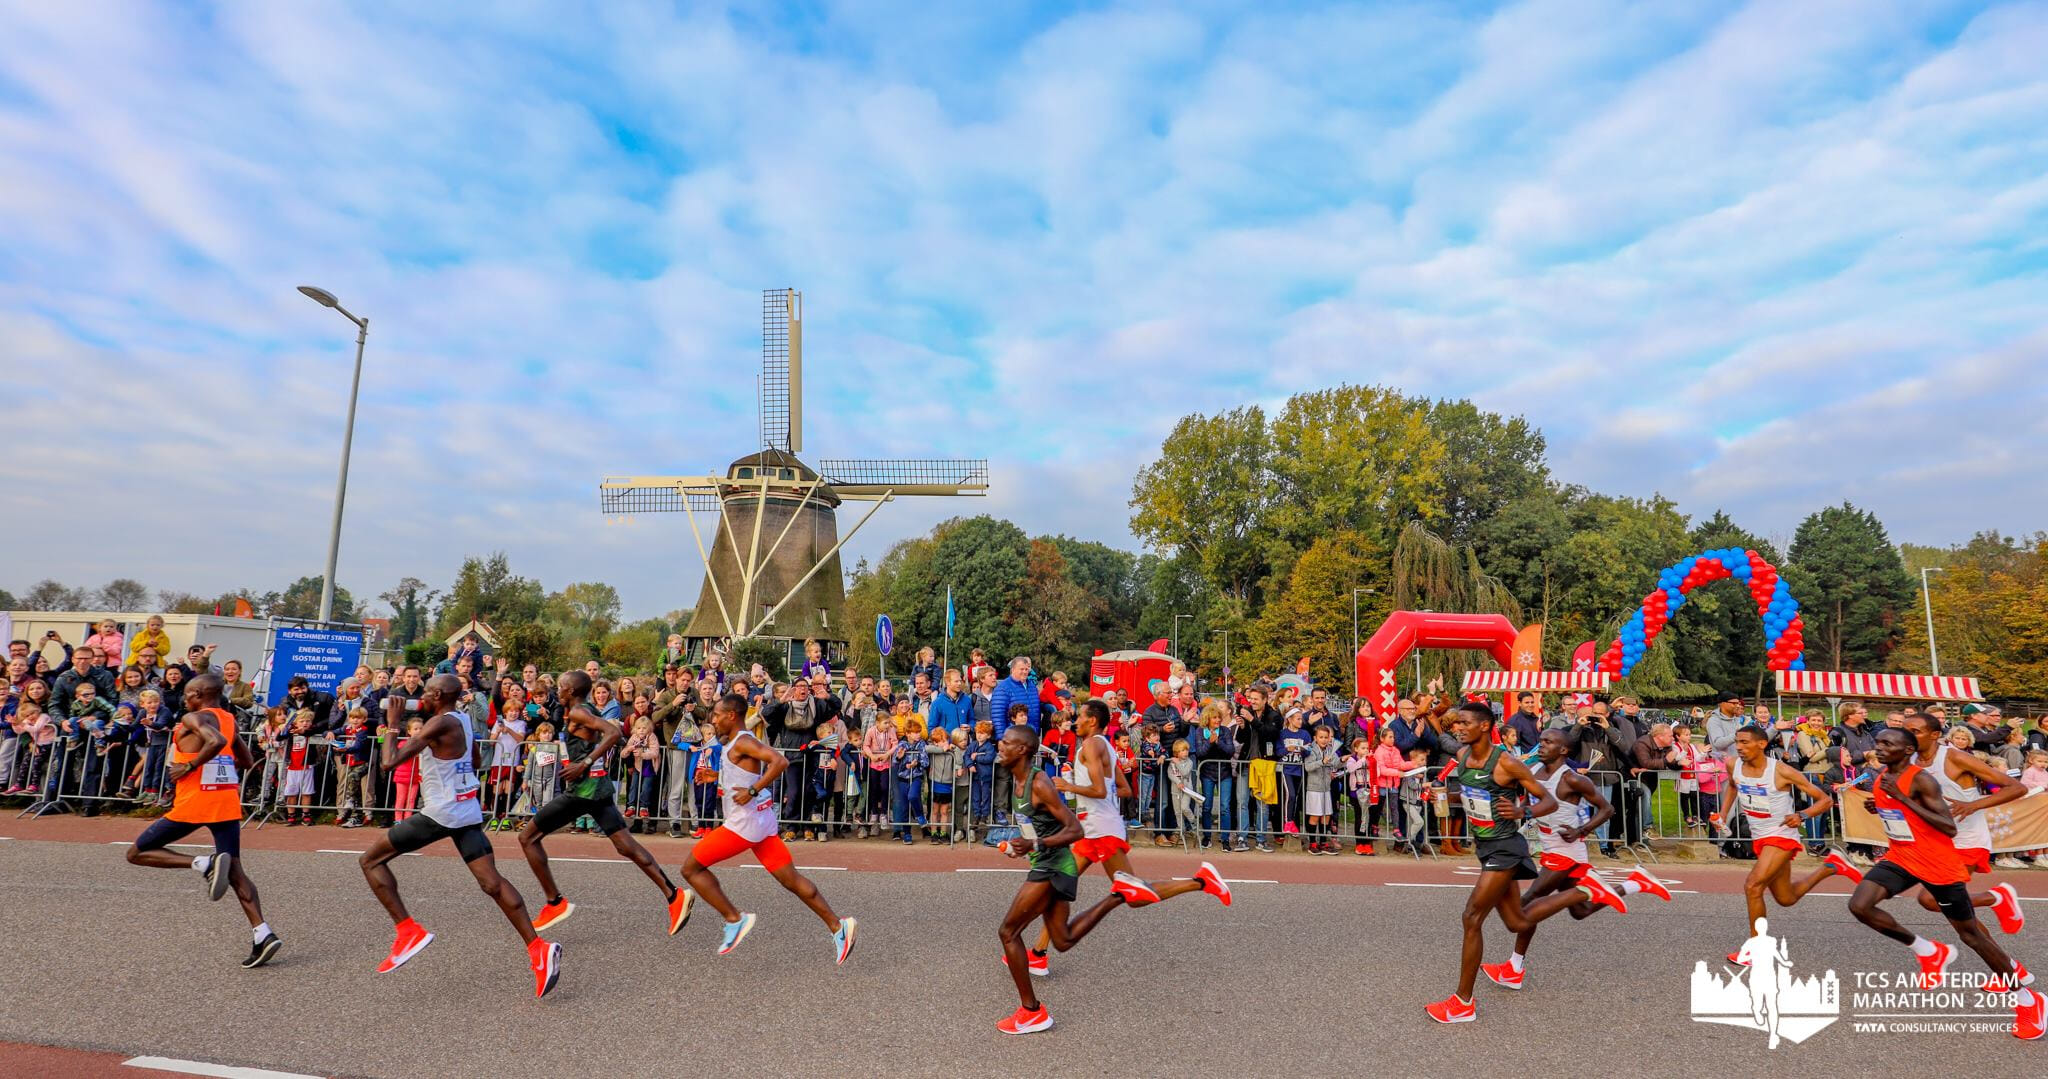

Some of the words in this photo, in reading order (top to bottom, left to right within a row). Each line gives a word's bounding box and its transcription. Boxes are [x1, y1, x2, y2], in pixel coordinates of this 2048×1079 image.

[282, 632, 330, 640] REFRESHMENT
[1469, 798, 1475, 810] 8
[1884, 820, 1891, 831] 1
